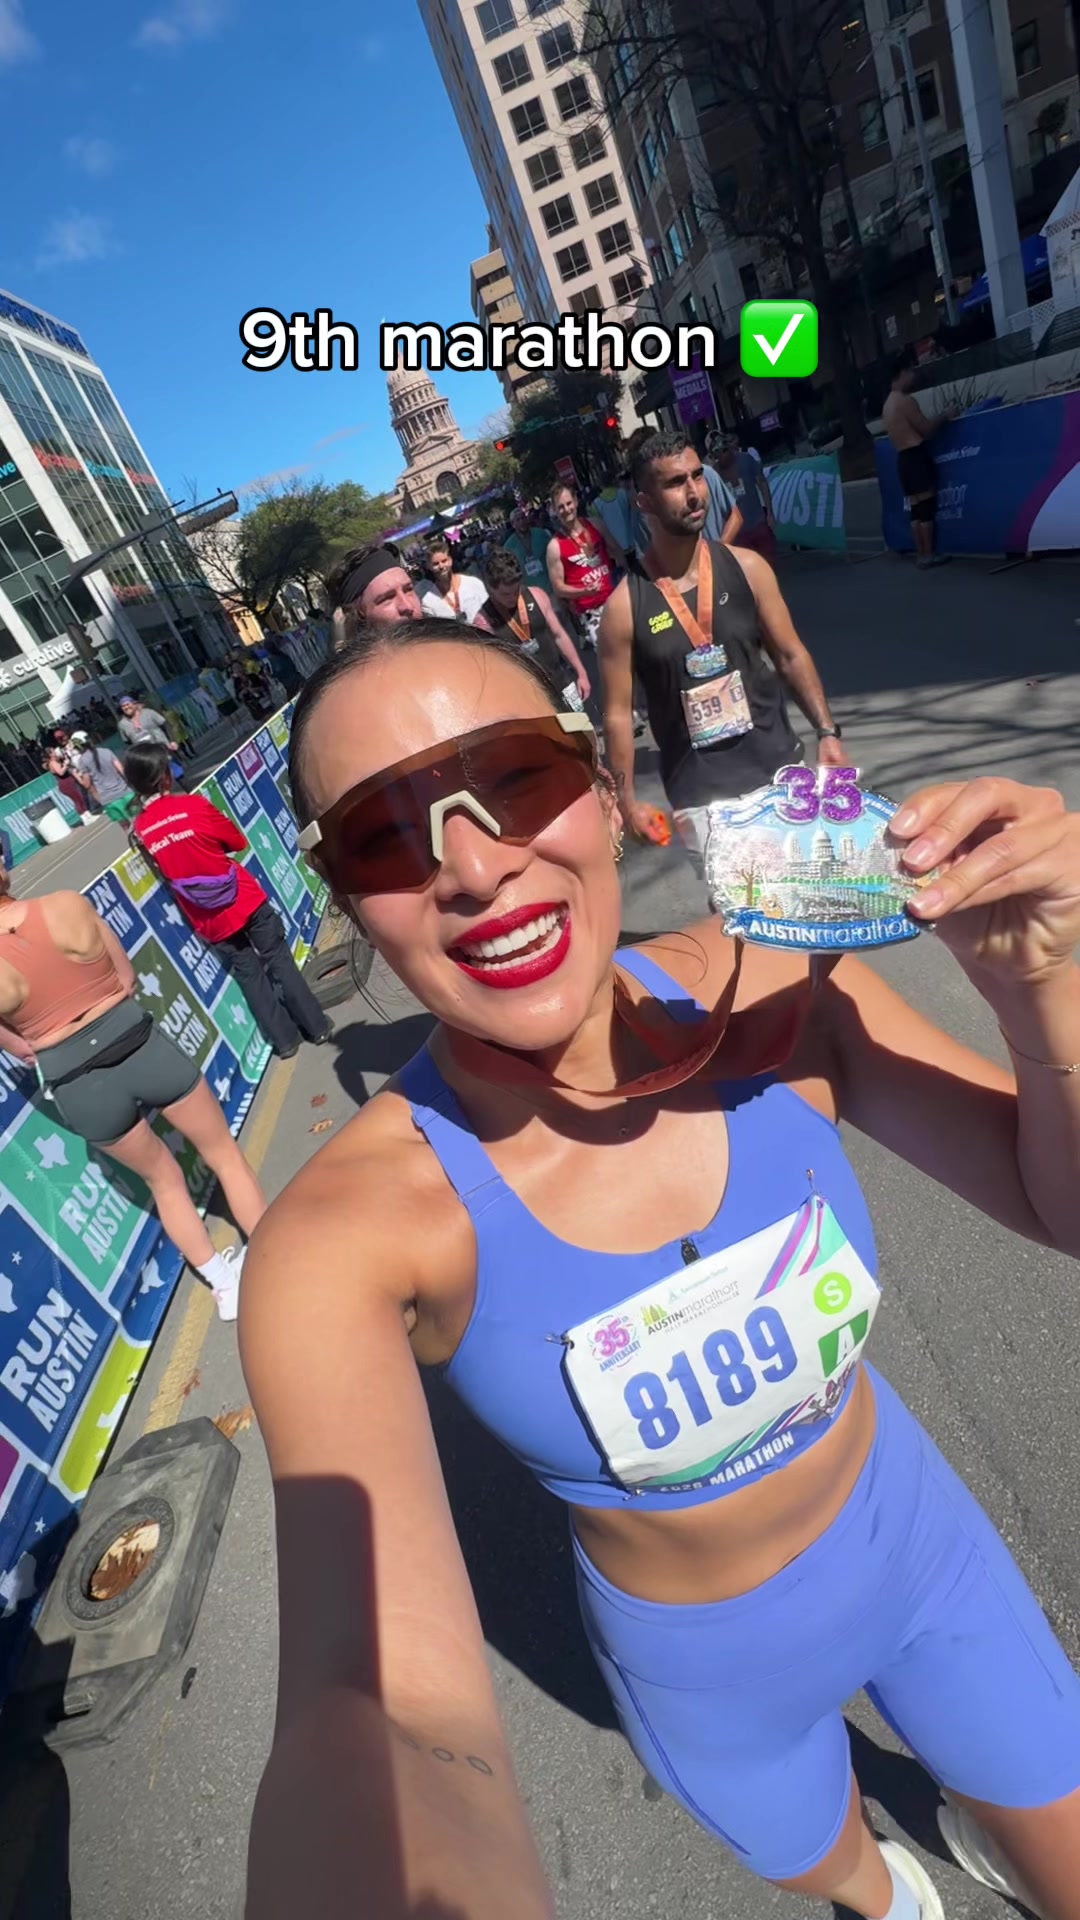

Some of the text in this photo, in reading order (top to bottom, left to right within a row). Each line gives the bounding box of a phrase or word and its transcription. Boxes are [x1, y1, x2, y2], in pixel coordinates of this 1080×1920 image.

[691, 696, 723, 722] 559
[222, 769, 244, 799] RUN
[769, 763, 866, 827] 35
[168, 828, 195, 843] Team
[273, 807, 291, 834] RUN
[179, 934, 207, 971] RU
[823, 1279, 846, 1308] S
[0, 1287, 73, 1402] RUN
[599, 1340, 642, 1372] ANNIVERSARY
[836, 1322, 856, 1366] A
[27, 1311, 99, 1433] AUSTIN
[623, 1306, 798, 1450] 8189
[710, 1430, 796, 1487] MARATHON
